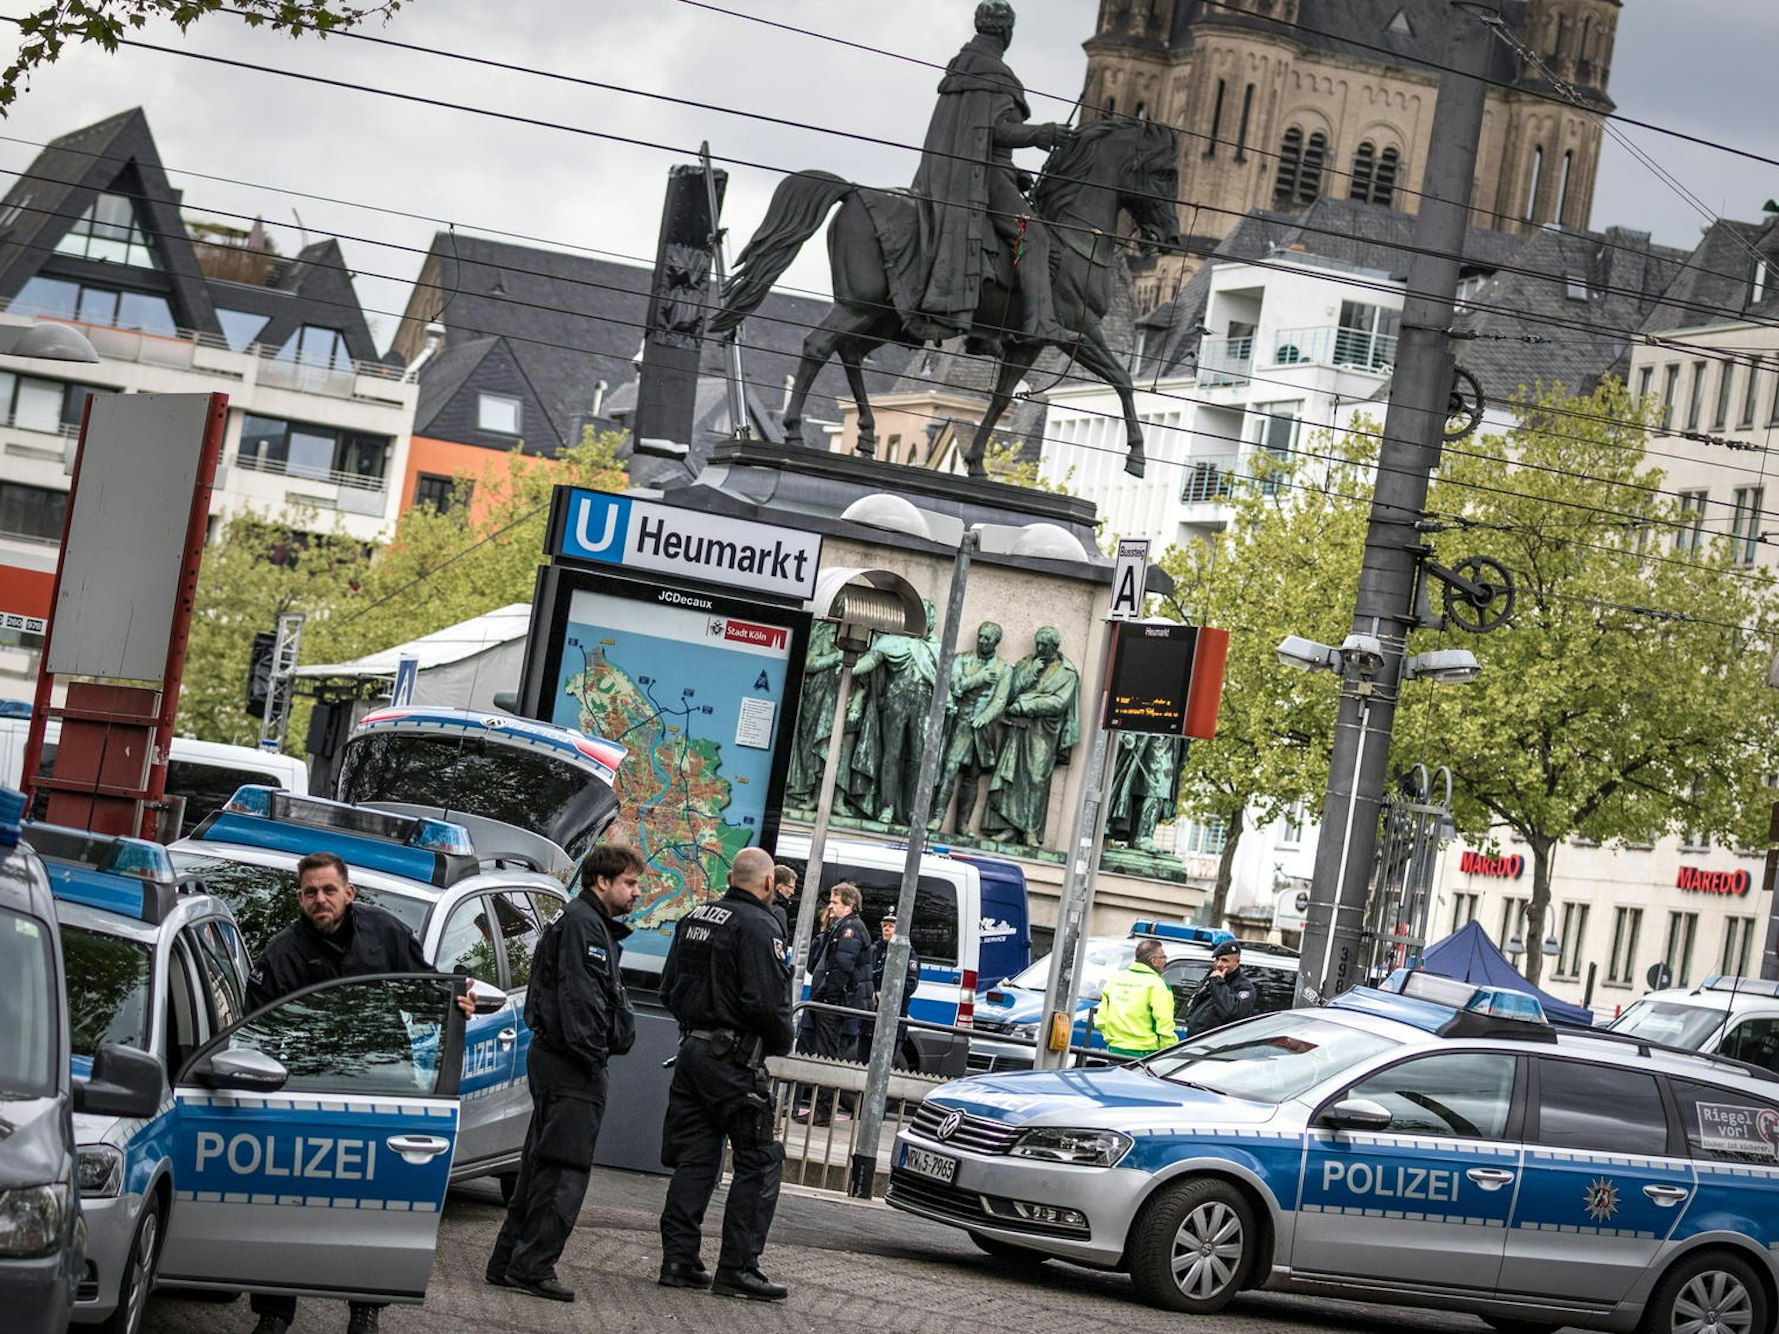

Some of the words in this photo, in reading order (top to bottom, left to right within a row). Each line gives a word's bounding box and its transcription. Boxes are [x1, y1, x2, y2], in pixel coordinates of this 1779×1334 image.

[575, 498, 619, 552] U
[636, 516, 808, 583] Heumarkt
[1119, 546, 1145, 560] Bussteig
[658, 590, 713, 609] JCDecaux
[1113, 565, 1135, 612] A
[726, 626, 748, 638] Stadt
[749, 630, 767, 641] Köln
[1460, 851, 1522, 877] MAREDO
[1675, 866, 1749, 896] MAREDO
[687, 905, 733, 926] POLIZEI
[685, 926, 711, 941] NRW
[461, 1038, 497, 1080] LIZEI
[1702, 1107, 1753, 1127] Riegel
[1717, 1124, 1749, 1138] vor!
[194, 1131, 377, 1180] POLIZEI
[1322, 1160, 1460, 1202] POLIZEI
